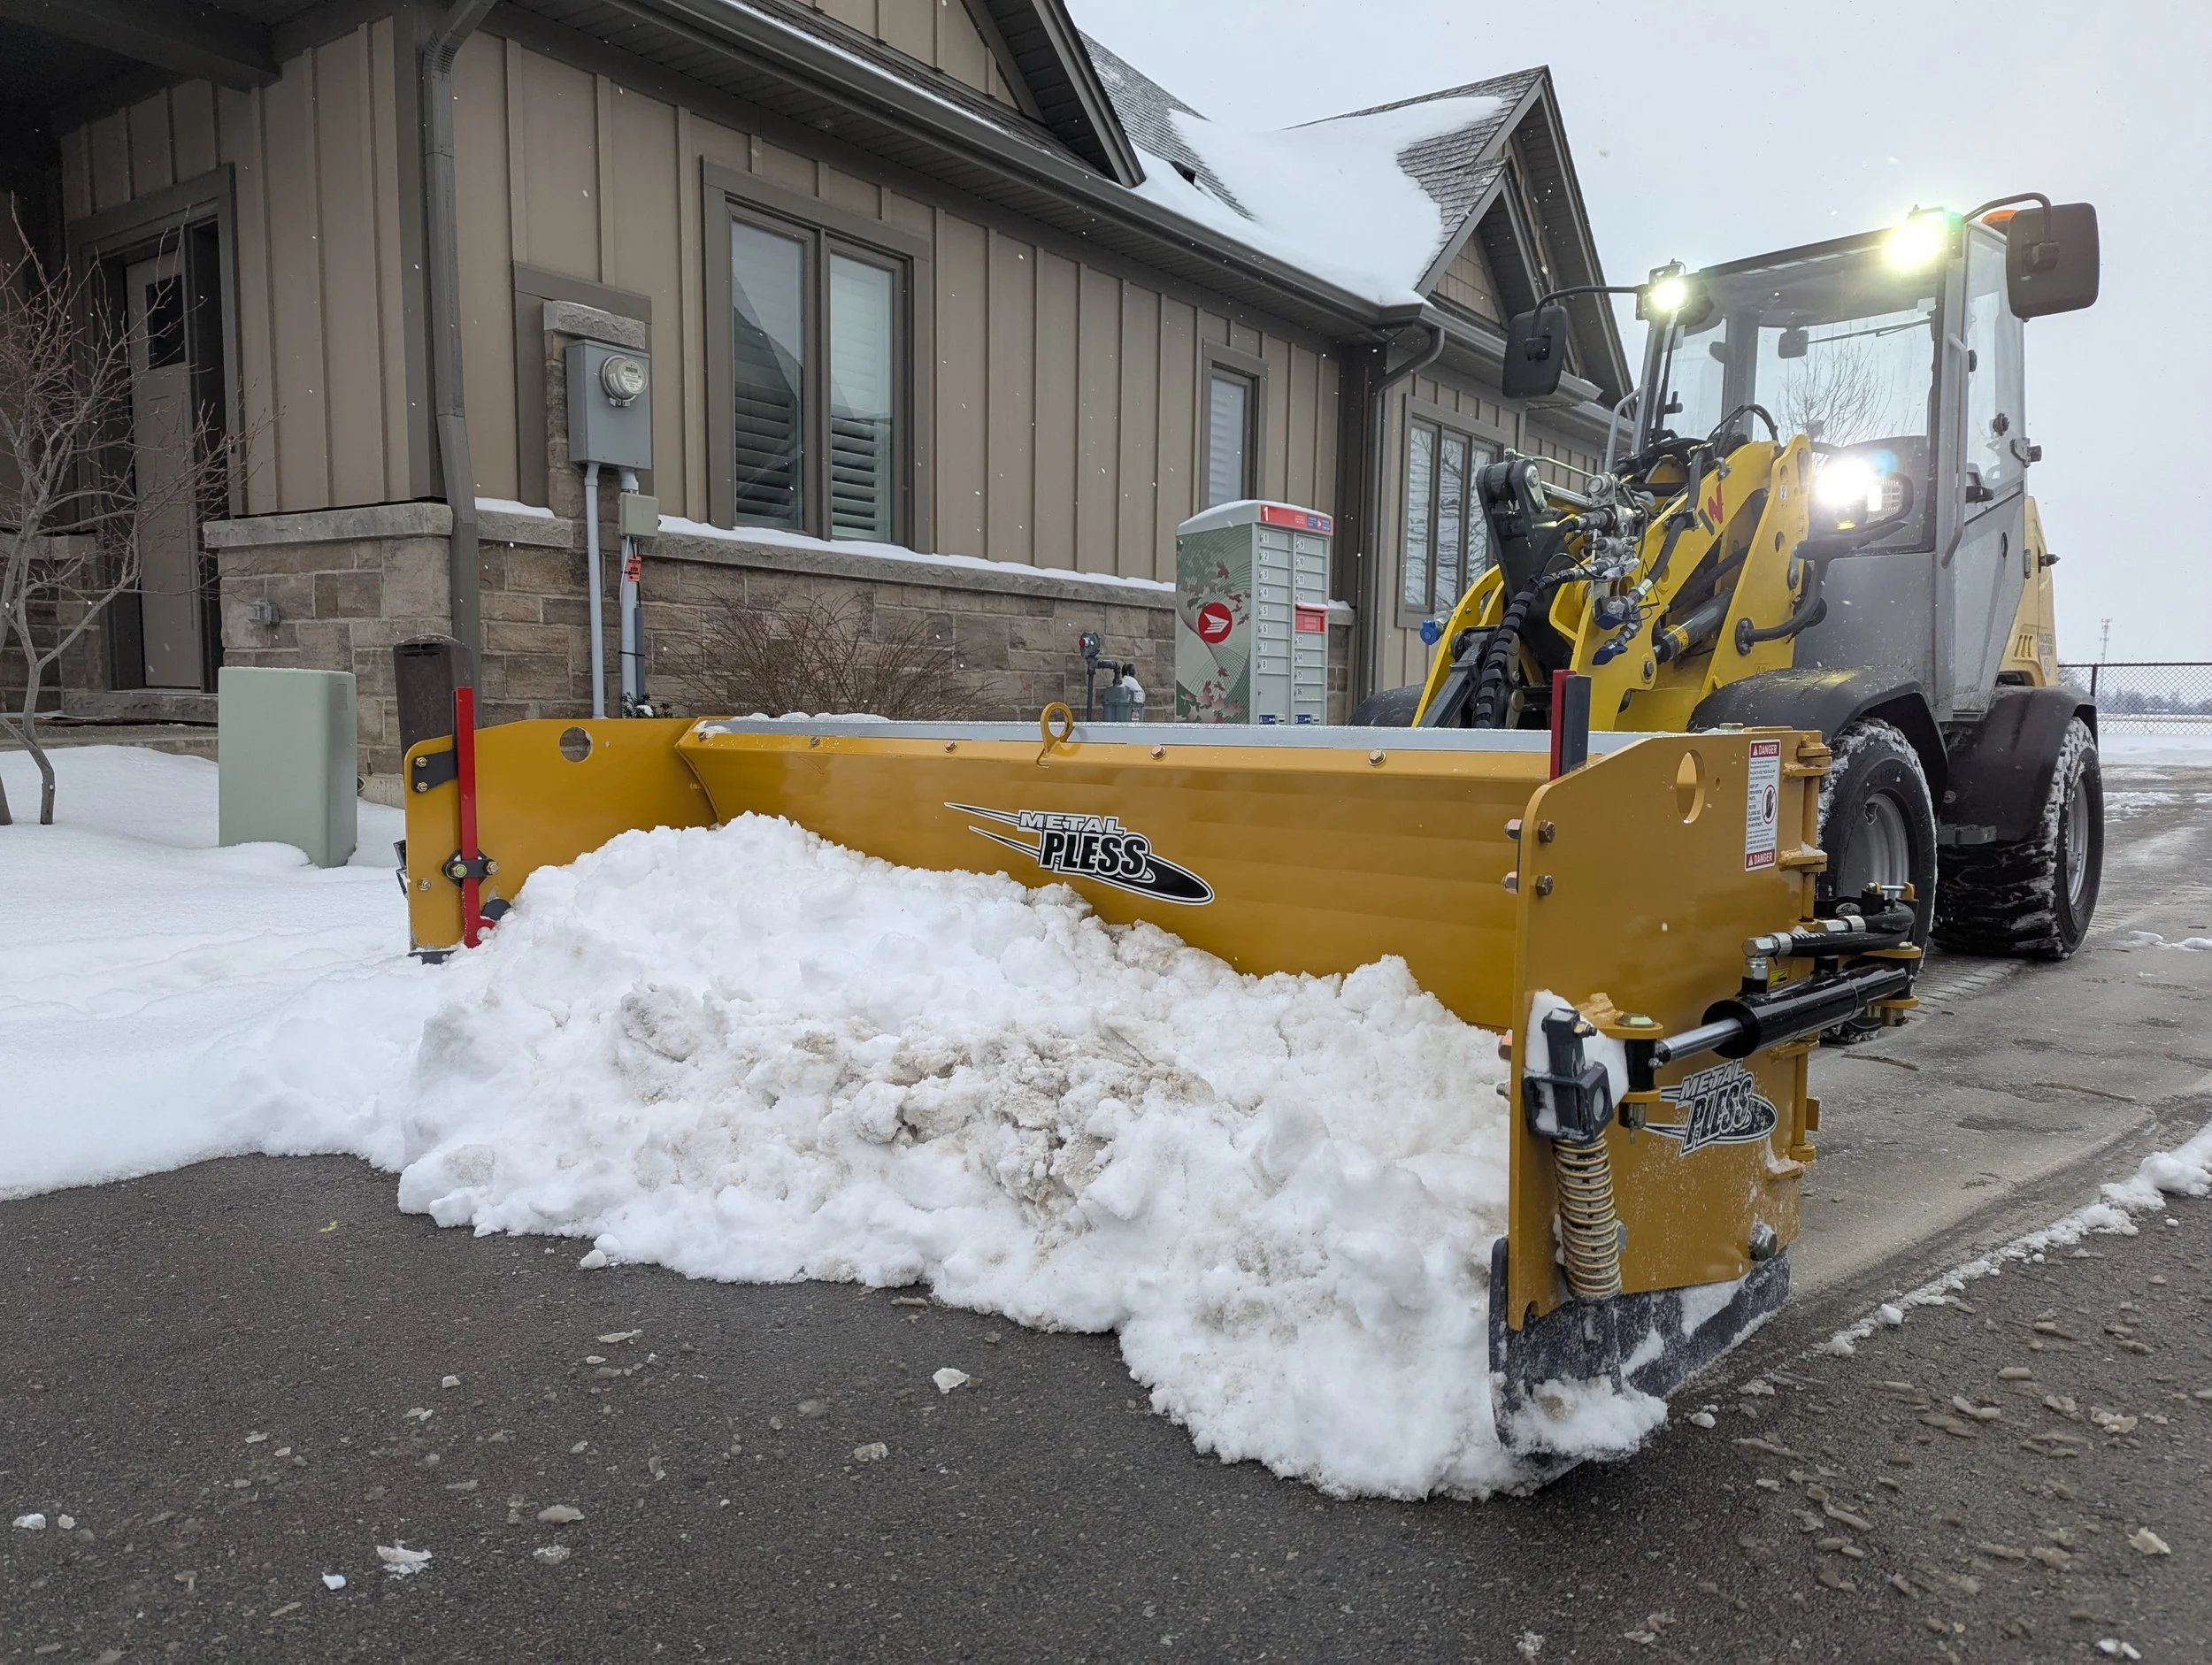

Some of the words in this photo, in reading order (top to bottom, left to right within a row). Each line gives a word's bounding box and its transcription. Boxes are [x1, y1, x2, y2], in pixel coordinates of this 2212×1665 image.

[1263, 506, 1269, 522] 1
[1758, 744, 1778, 756] DANGER
[1019, 810, 1126, 835] METAL
[1040, 832, 1149, 877] PLESS
[1754, 851, 1773, 865] DANGER
[1679, 1059, 1746, 1101] METAL
[1683, 1078, 1753, 1150] PLESS
